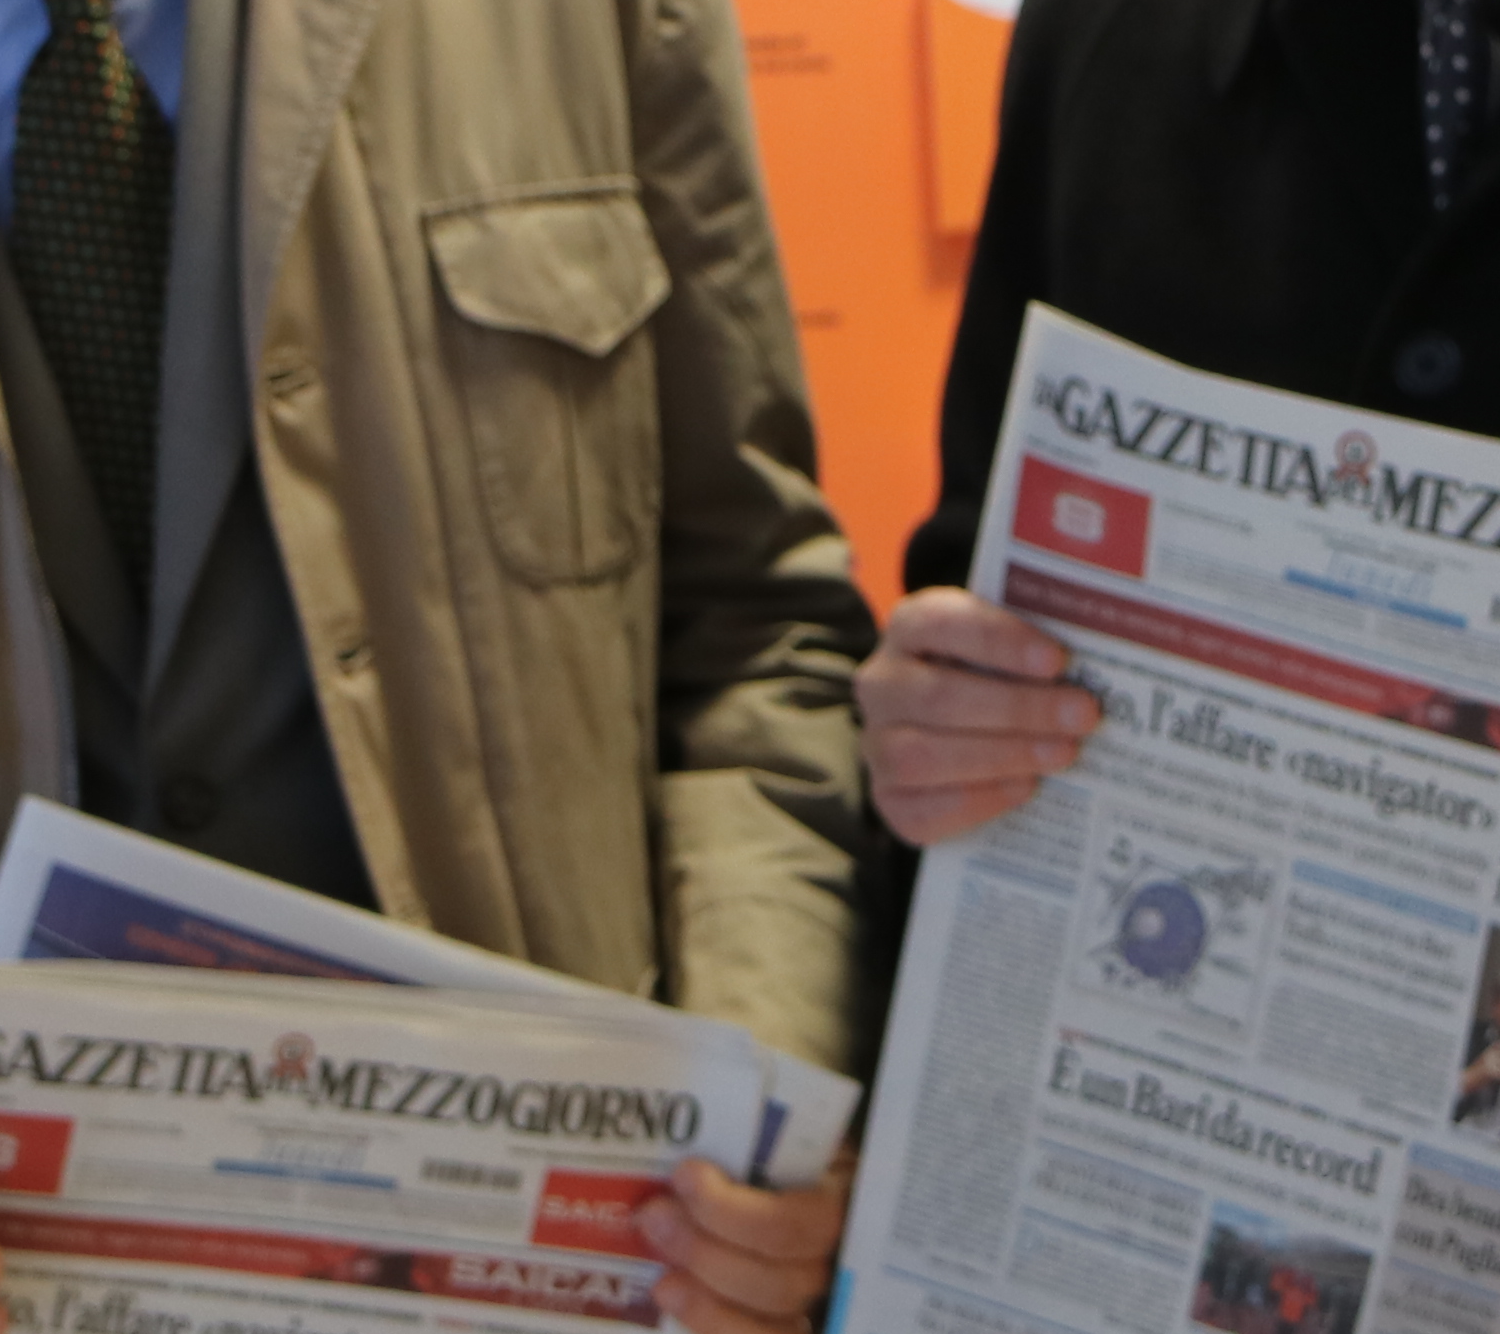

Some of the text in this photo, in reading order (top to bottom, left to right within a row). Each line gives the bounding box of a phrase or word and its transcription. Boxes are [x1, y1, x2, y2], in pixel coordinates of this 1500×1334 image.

[1055, 374, 1327, 509] GAZZETTA
[318, 1055, 702, 1143] MEZZOGIORNO
[1131, 1071, 1211, 1137] Bari
[1209, 1099, 1255, 1153] da
[1257, 1128, 1383, 1197] record
